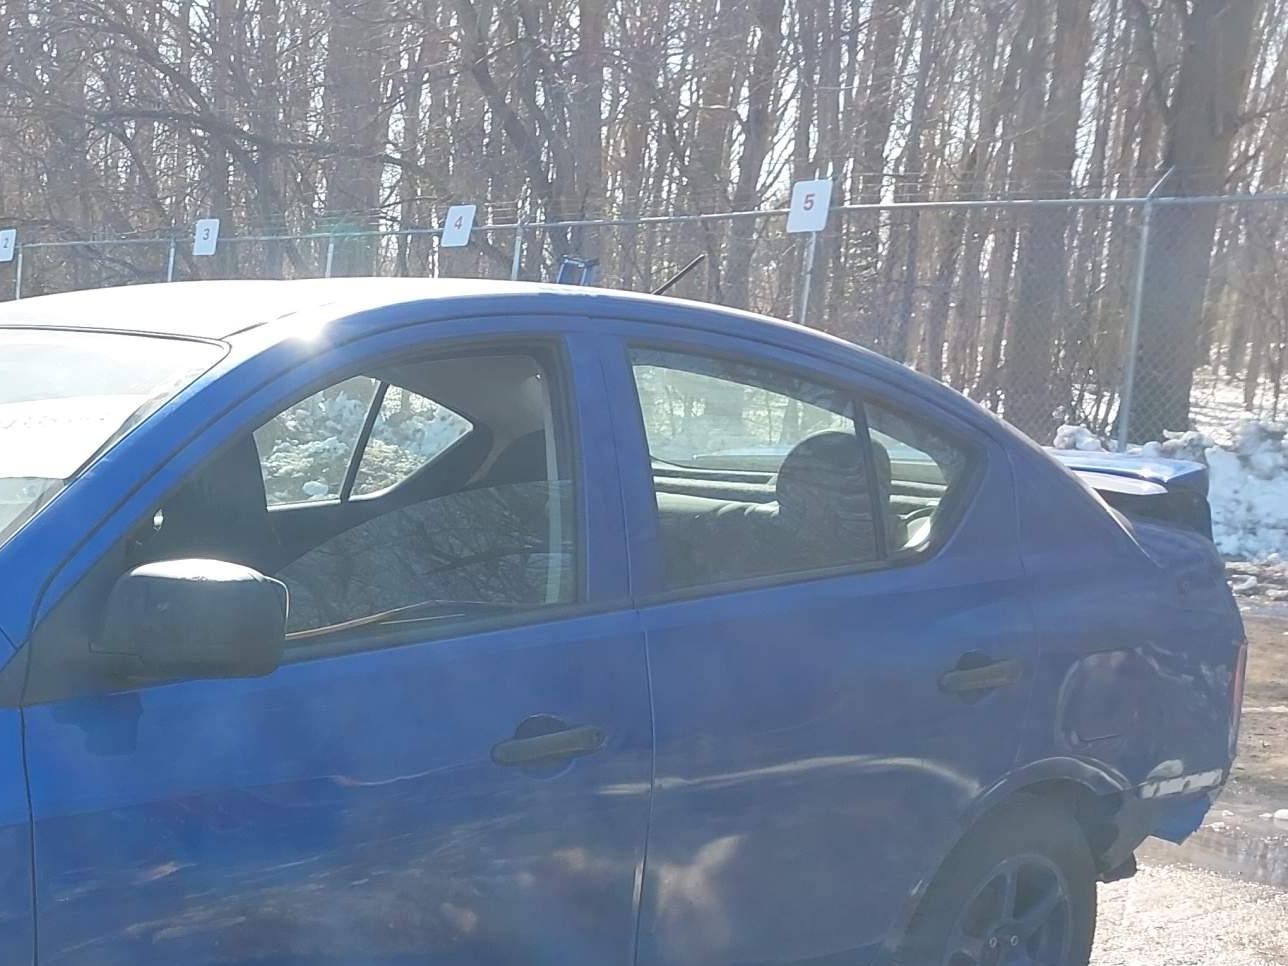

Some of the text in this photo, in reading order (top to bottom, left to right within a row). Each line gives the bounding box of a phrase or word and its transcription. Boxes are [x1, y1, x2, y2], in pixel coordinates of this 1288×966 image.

[803, 193, 815, 211] 5
[454, 215, 463, 229] 4
[202, 228, 210, 240] 3
[2, 237, 10, 249] 2
